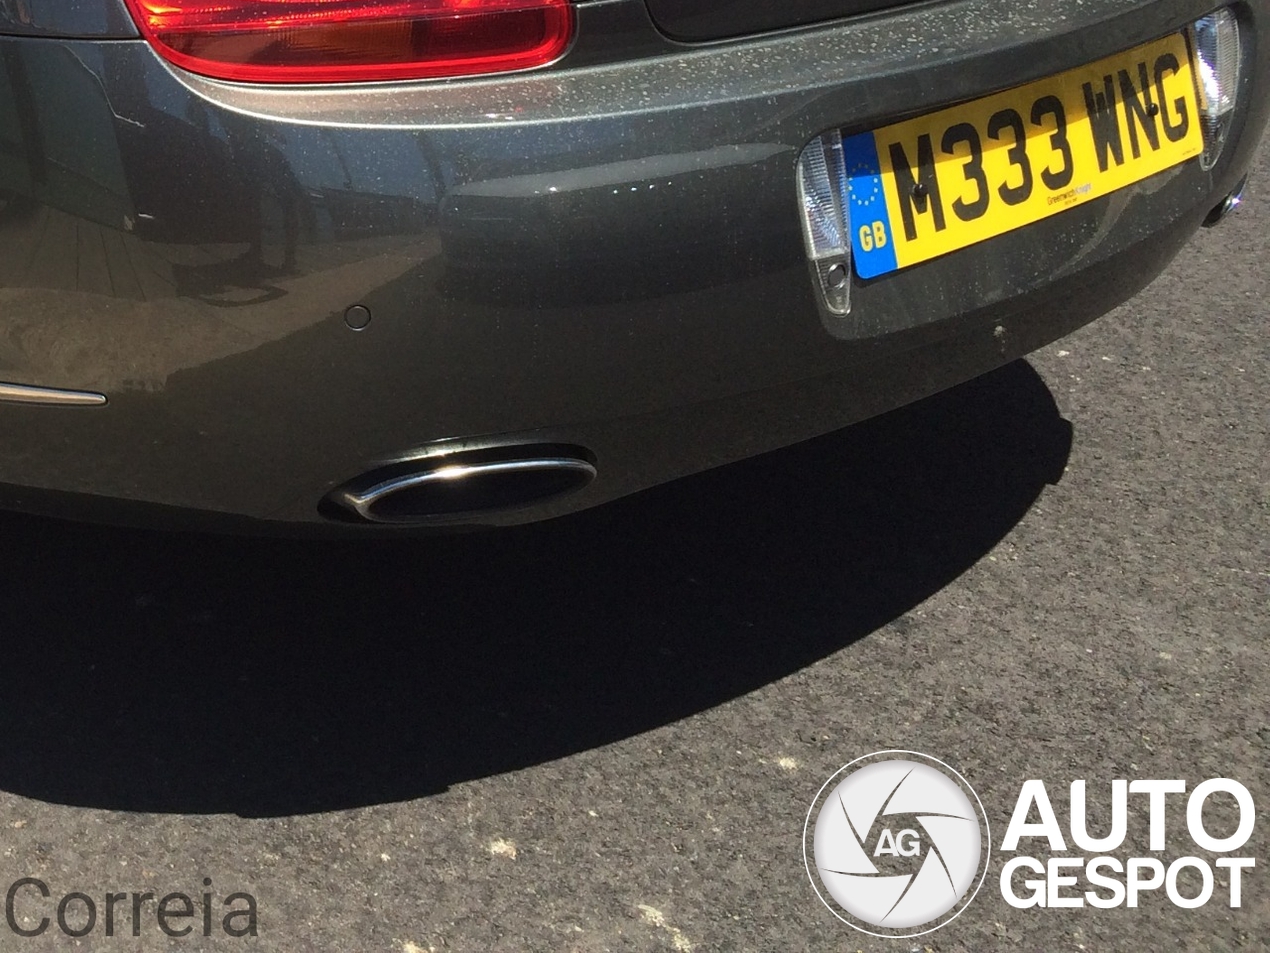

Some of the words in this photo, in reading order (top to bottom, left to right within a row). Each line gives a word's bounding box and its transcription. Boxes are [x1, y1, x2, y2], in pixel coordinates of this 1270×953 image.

[888, 94, 1075, 242] M333
[1081, 52, 1190, 174] WNG
[858, 220, 888, 253] GB
